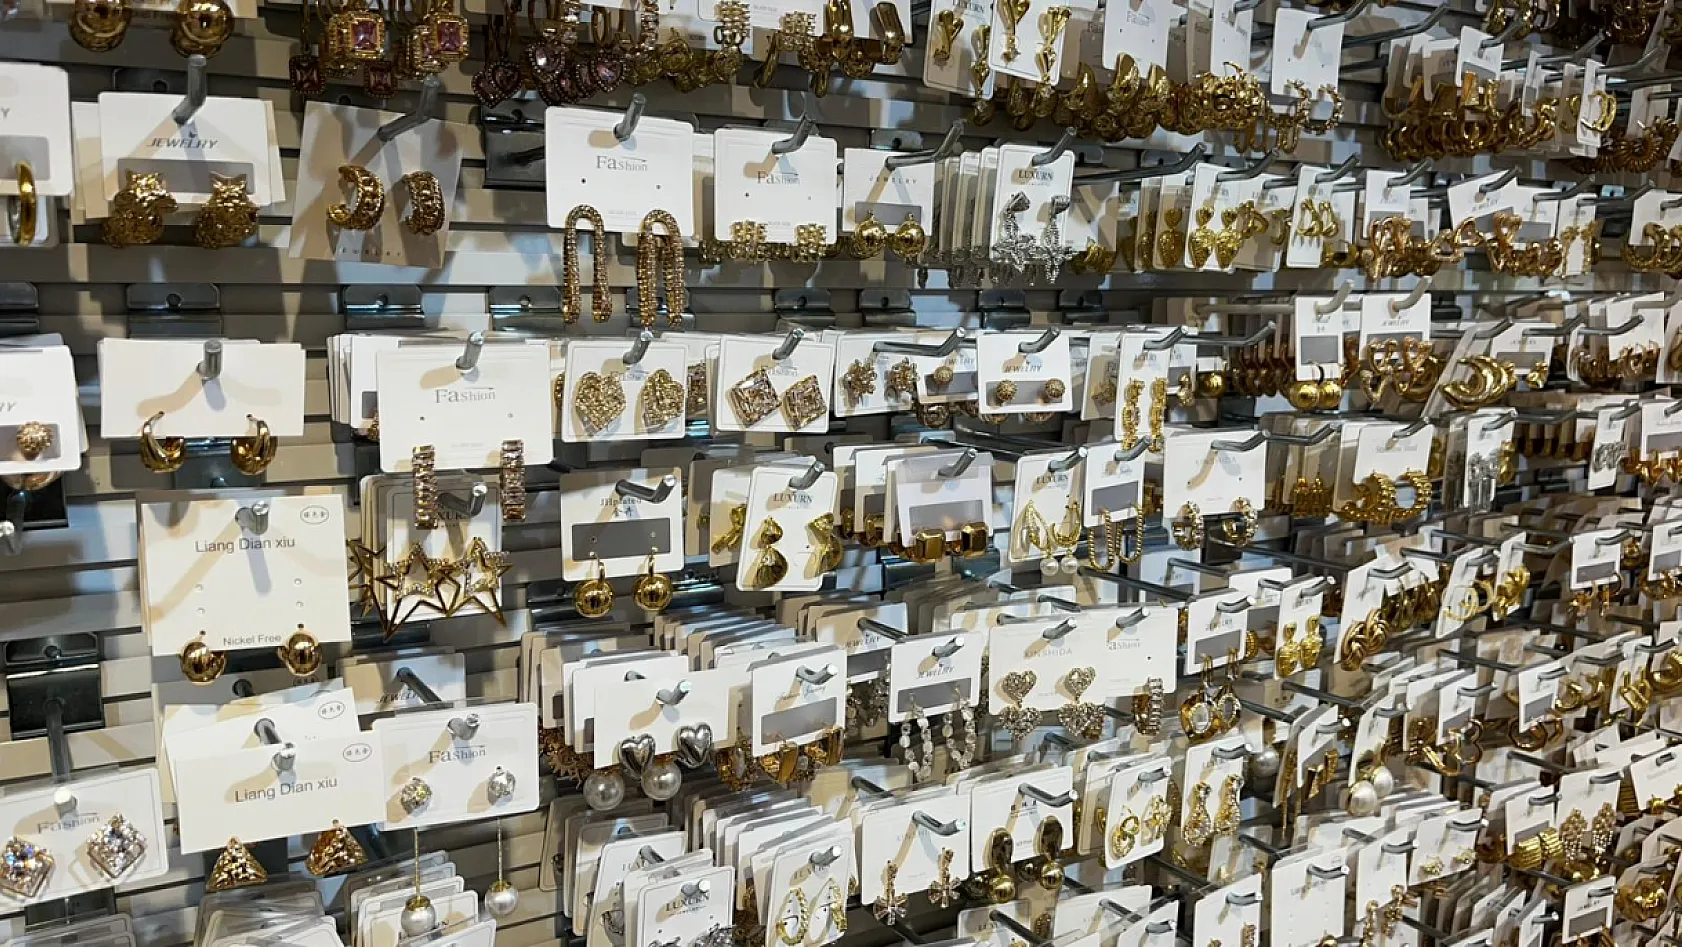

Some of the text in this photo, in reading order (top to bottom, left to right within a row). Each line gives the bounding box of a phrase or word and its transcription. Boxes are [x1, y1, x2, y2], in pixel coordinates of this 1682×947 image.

[596, 155, 648, 172] Fashion
[435, 387, 496, 404] Fashion
[195, 535, 296, 554] Liang Dian xiu
[223, 633, 282, 646] Nickel Free
[429, 745, 487, 764] Fashion
[235, 776, 338, 803] Liang Dian xiu
[37, 813, 99, 835] Fashion
